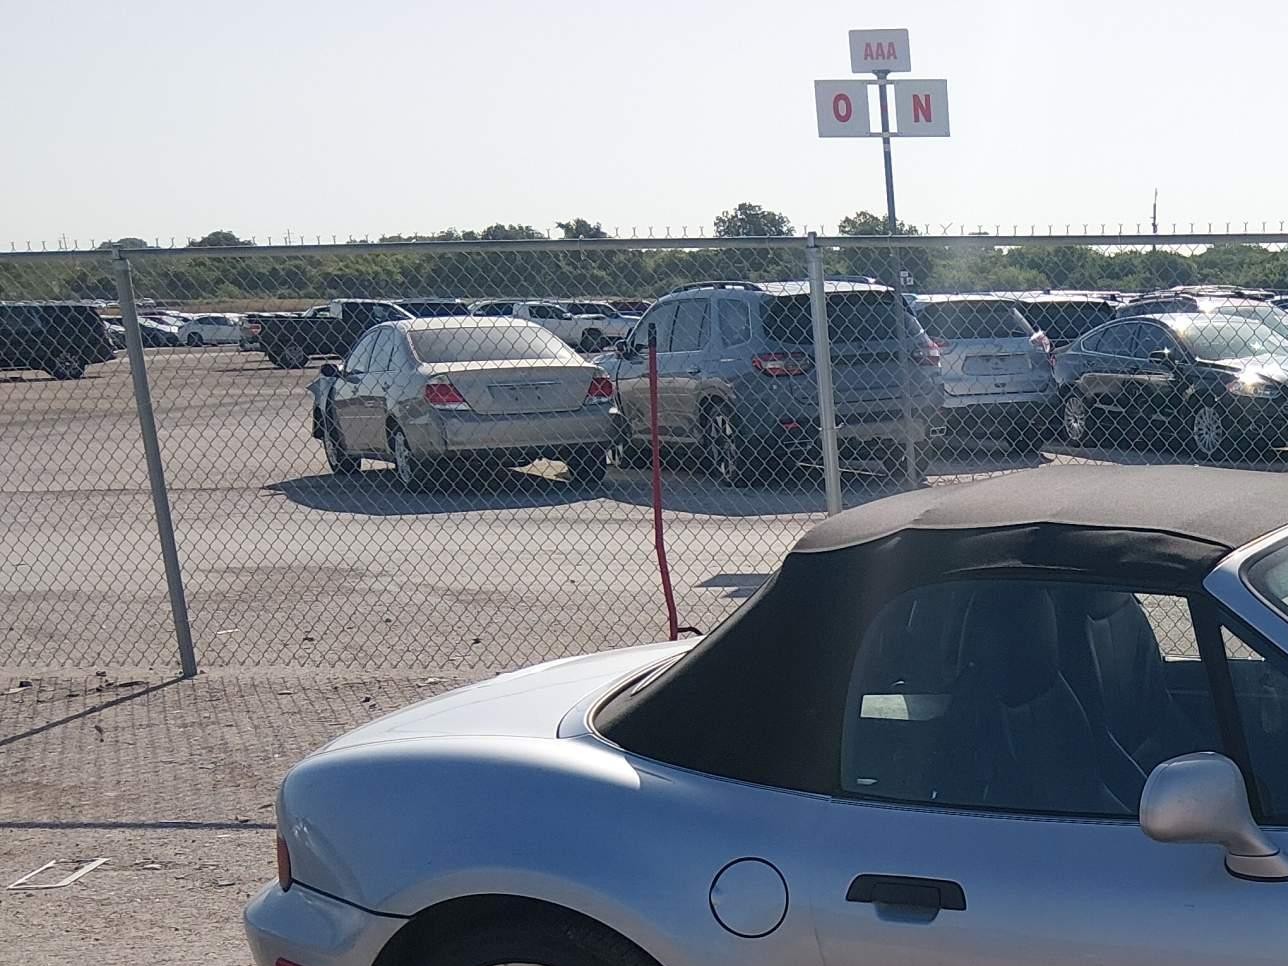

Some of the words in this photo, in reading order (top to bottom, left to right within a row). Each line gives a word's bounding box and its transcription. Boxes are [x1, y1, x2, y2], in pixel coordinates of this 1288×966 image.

[863, 42, 898, 60] AAA
[832, 93, 852, 123] O
[912, 94, 932, 123] N
